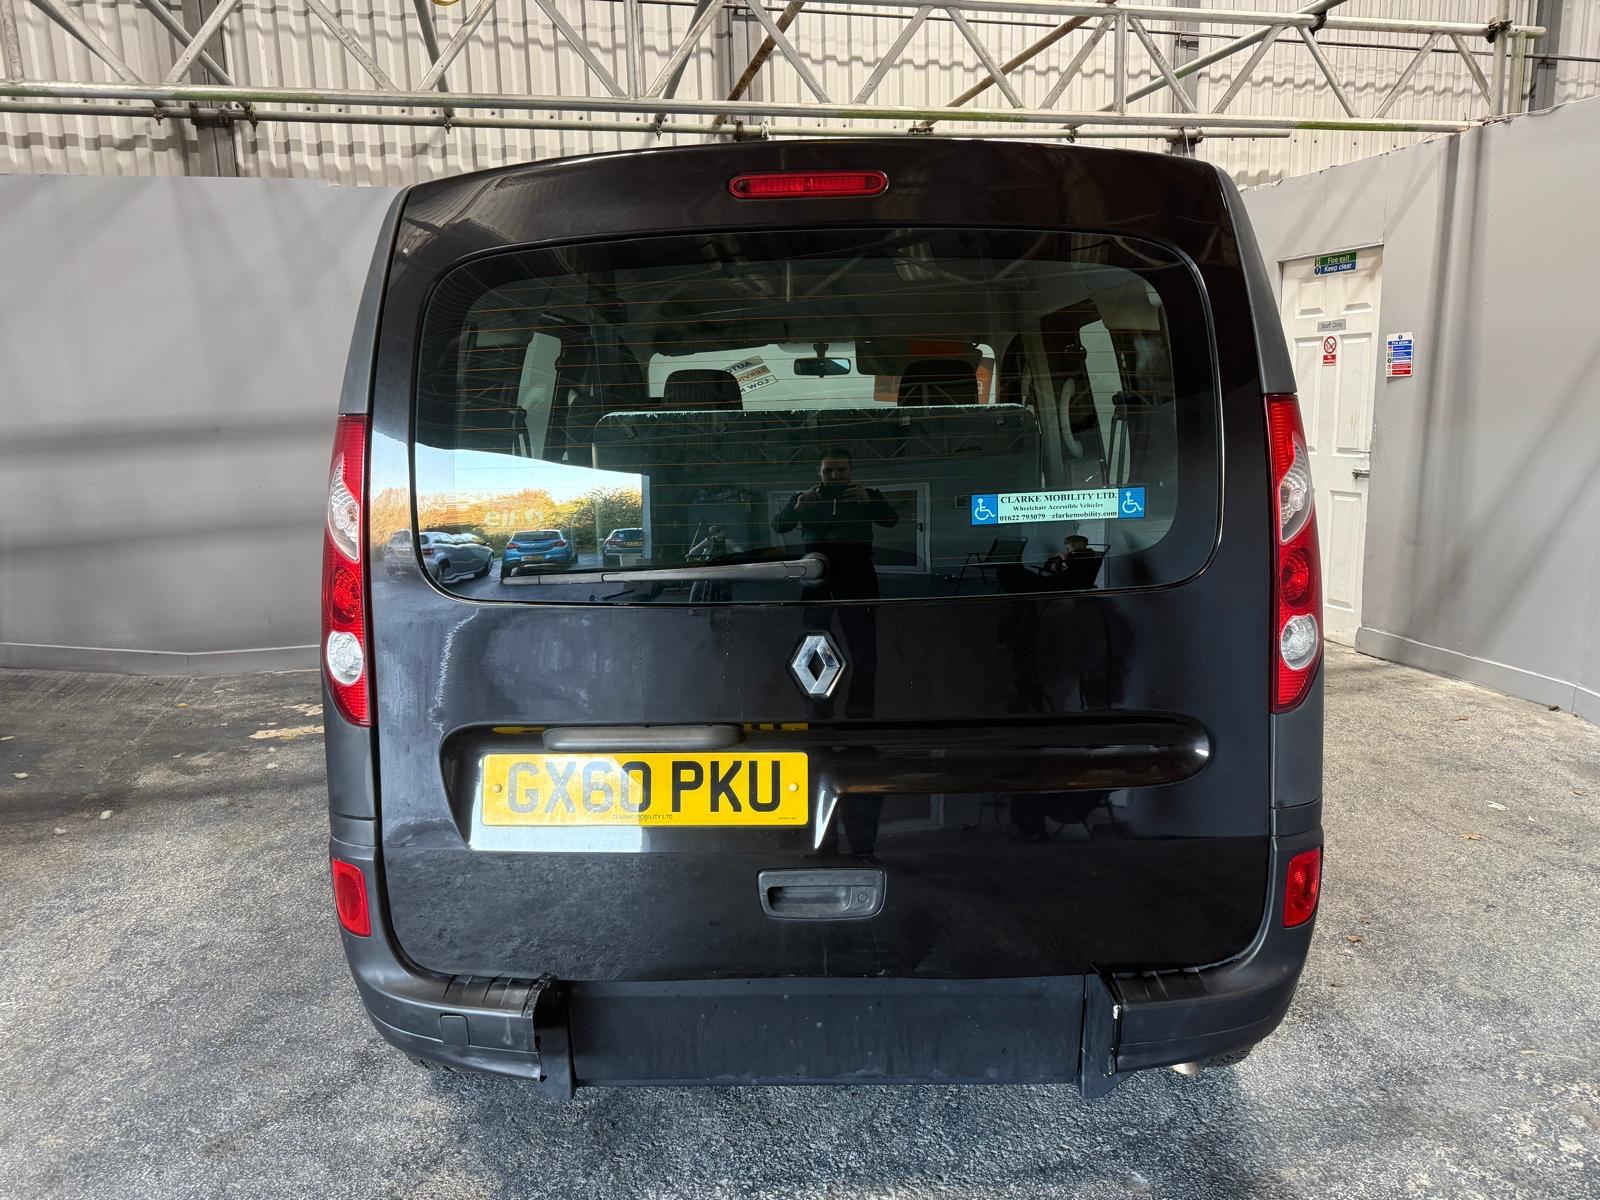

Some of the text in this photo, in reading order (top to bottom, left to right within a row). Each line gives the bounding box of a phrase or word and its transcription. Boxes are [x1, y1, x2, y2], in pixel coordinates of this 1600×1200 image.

[1327, 254, 1350, 264] Fire exit
[1324, 262, 1352, 273] Keep clear
[1000, 491, 1118, 504] CLARKE MOBILITY LTD.
[1013, 504, 1047, 512] Wheelchair
[1049, 503, 1079, 511] Accessible
[999, 510, 1118, 522] 01622 793079 clarkemobility.com
[507, 760, 781, 813] GX60 PKU
